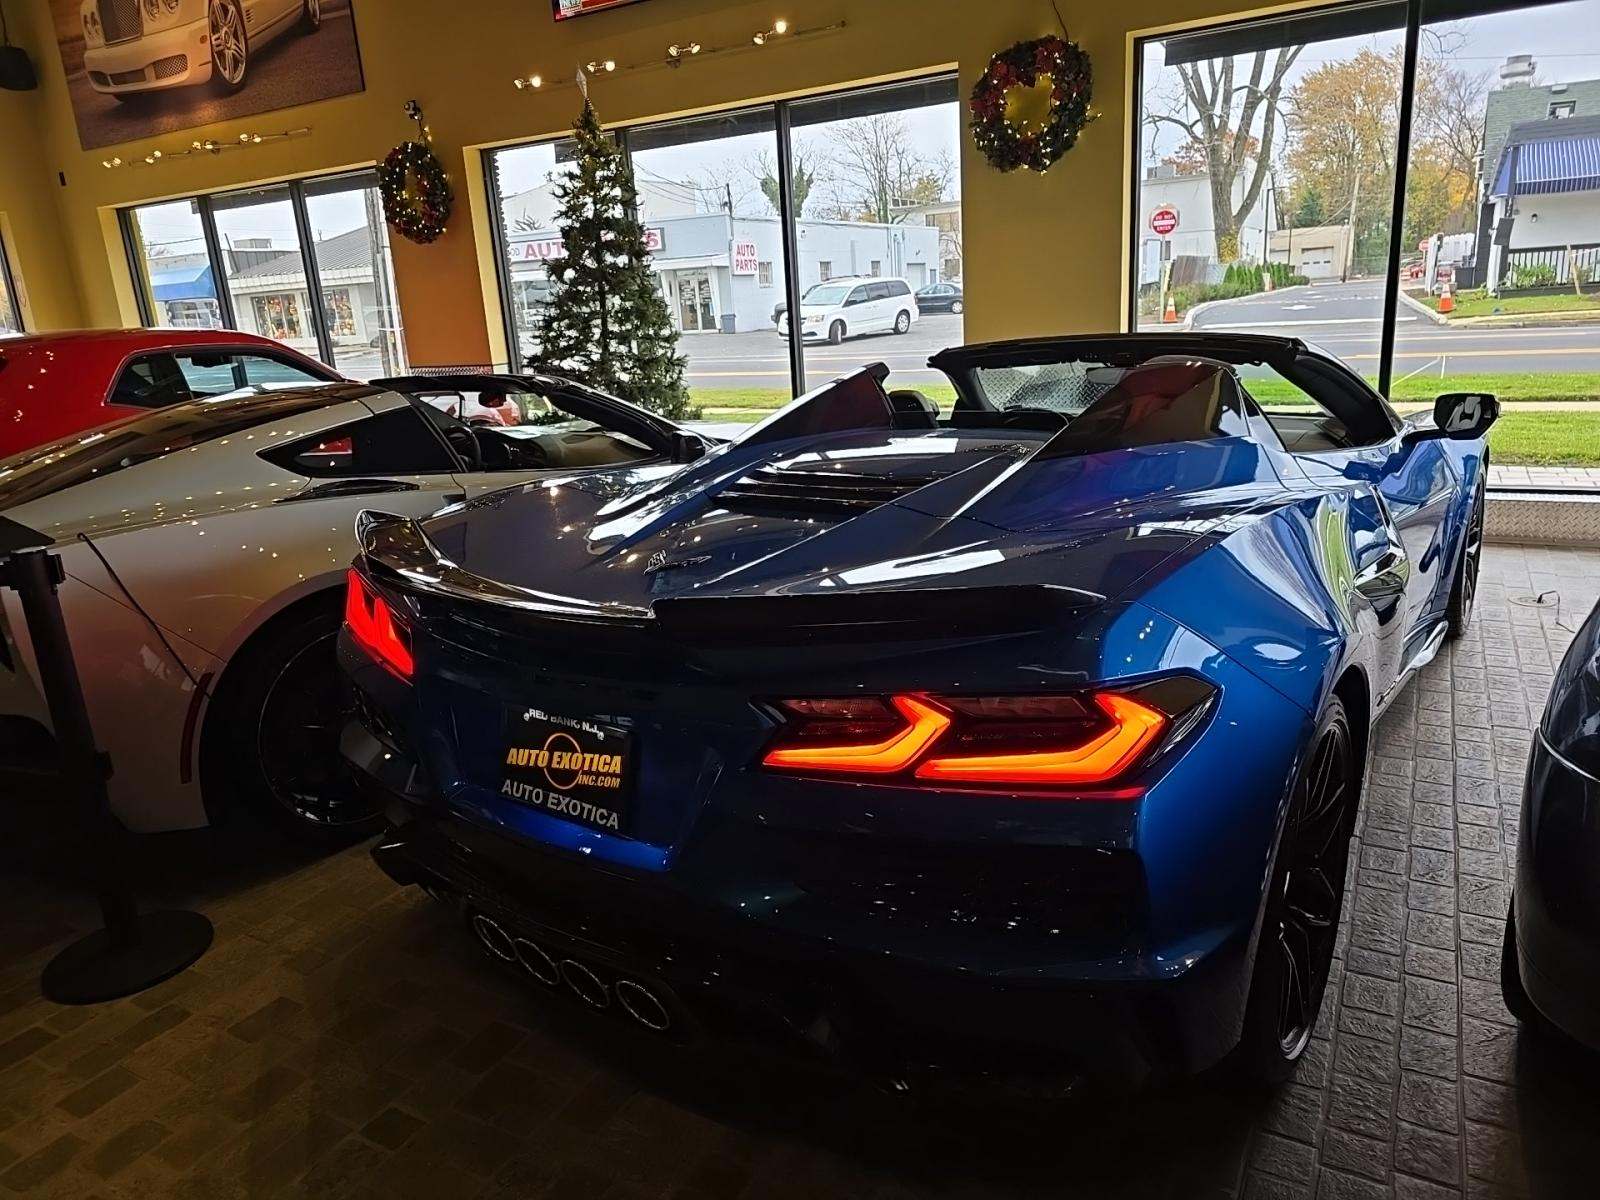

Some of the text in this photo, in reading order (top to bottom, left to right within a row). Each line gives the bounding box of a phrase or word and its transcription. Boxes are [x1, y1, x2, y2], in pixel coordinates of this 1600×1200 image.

[524, 241, 563, 259] AUT
[736, 244, 755, 257] AUTO
[735, 259, 758, 271] PARTS
[507, 748, 622, 774] AUTO EXOTICA
[578, 774, 621, 788] INC.COM
[502, 779, 619, 830] AUTO EXOTICA
